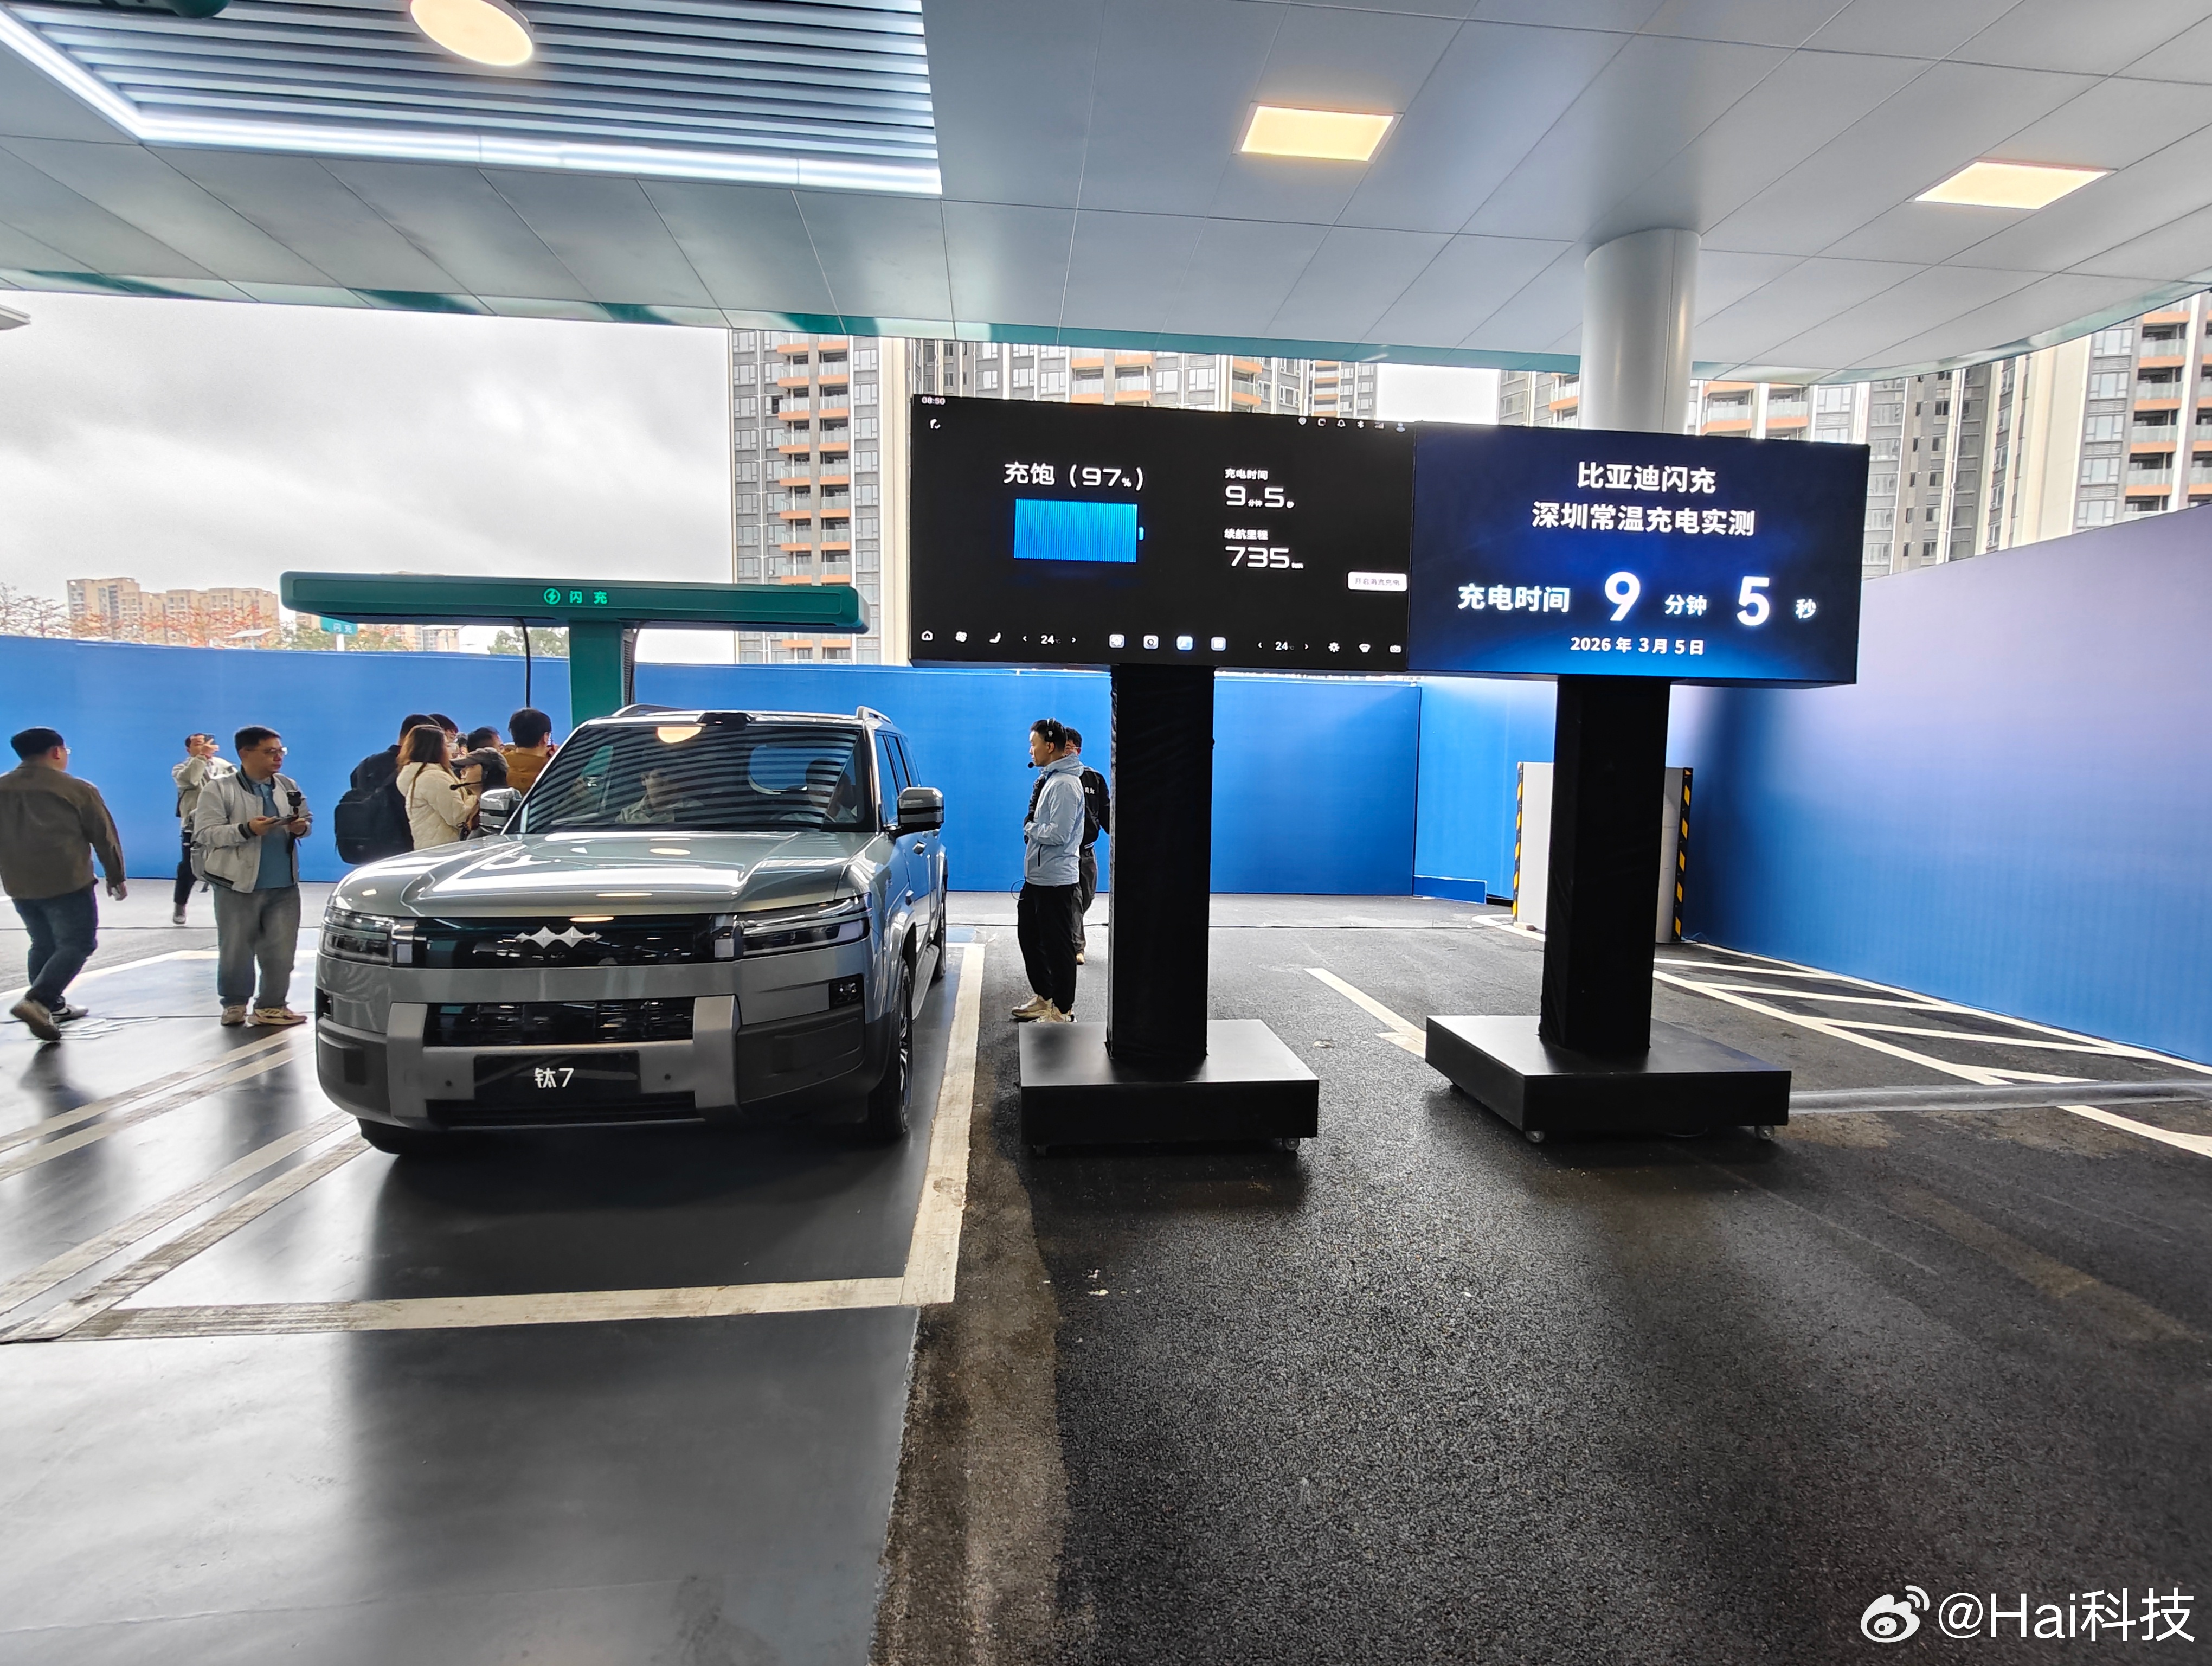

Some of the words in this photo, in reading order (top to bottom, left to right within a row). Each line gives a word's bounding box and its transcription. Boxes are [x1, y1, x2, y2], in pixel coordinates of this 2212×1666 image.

[922, 396, 946, 405] 08:50
[1224, 468, 1269, 480] 充电时间
[1577, 461, 1716, 494] 比亚迪闪充
[1532, 501, 1756, 536] 深圳常温充电实测
[1224, 528, 1269, 540] 续航里程
[569, 590, 608, 605] 闪充
[1457, 582, 1571, 613] 充电时间
[1604, 571, 1641, 622] 9
[1664, 594, 1708, 617] 分钟
[1737, 576, 1770, 626] 5
[1795, 598, 1817, 619] 秒
[534, 1067, 575, 1088] 钛7
